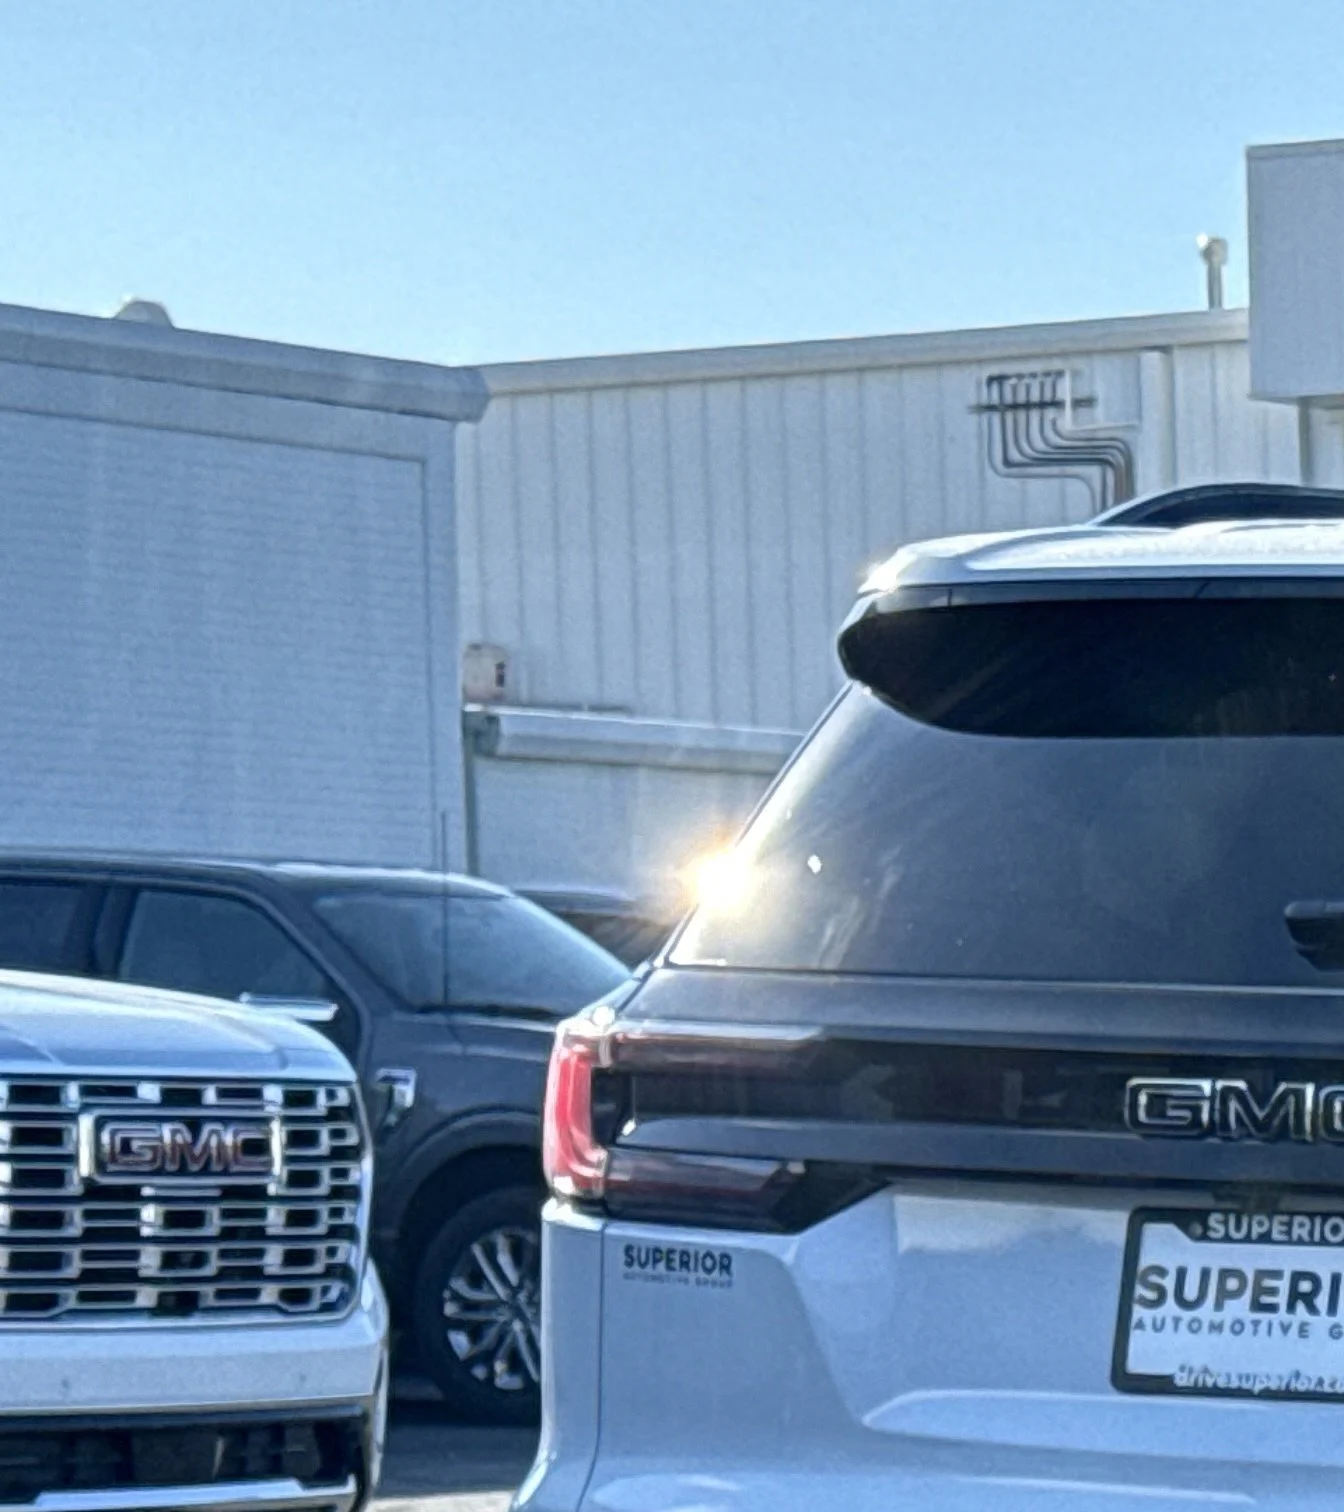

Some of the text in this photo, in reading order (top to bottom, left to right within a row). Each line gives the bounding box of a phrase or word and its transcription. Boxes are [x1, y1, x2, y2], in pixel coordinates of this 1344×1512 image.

[101, 1121, 271, 1172] GMC
[623, 1244, 733, 1277] SUPERIOR
[1132, 1315, 1312, 1340] AUTOMOTIVE
